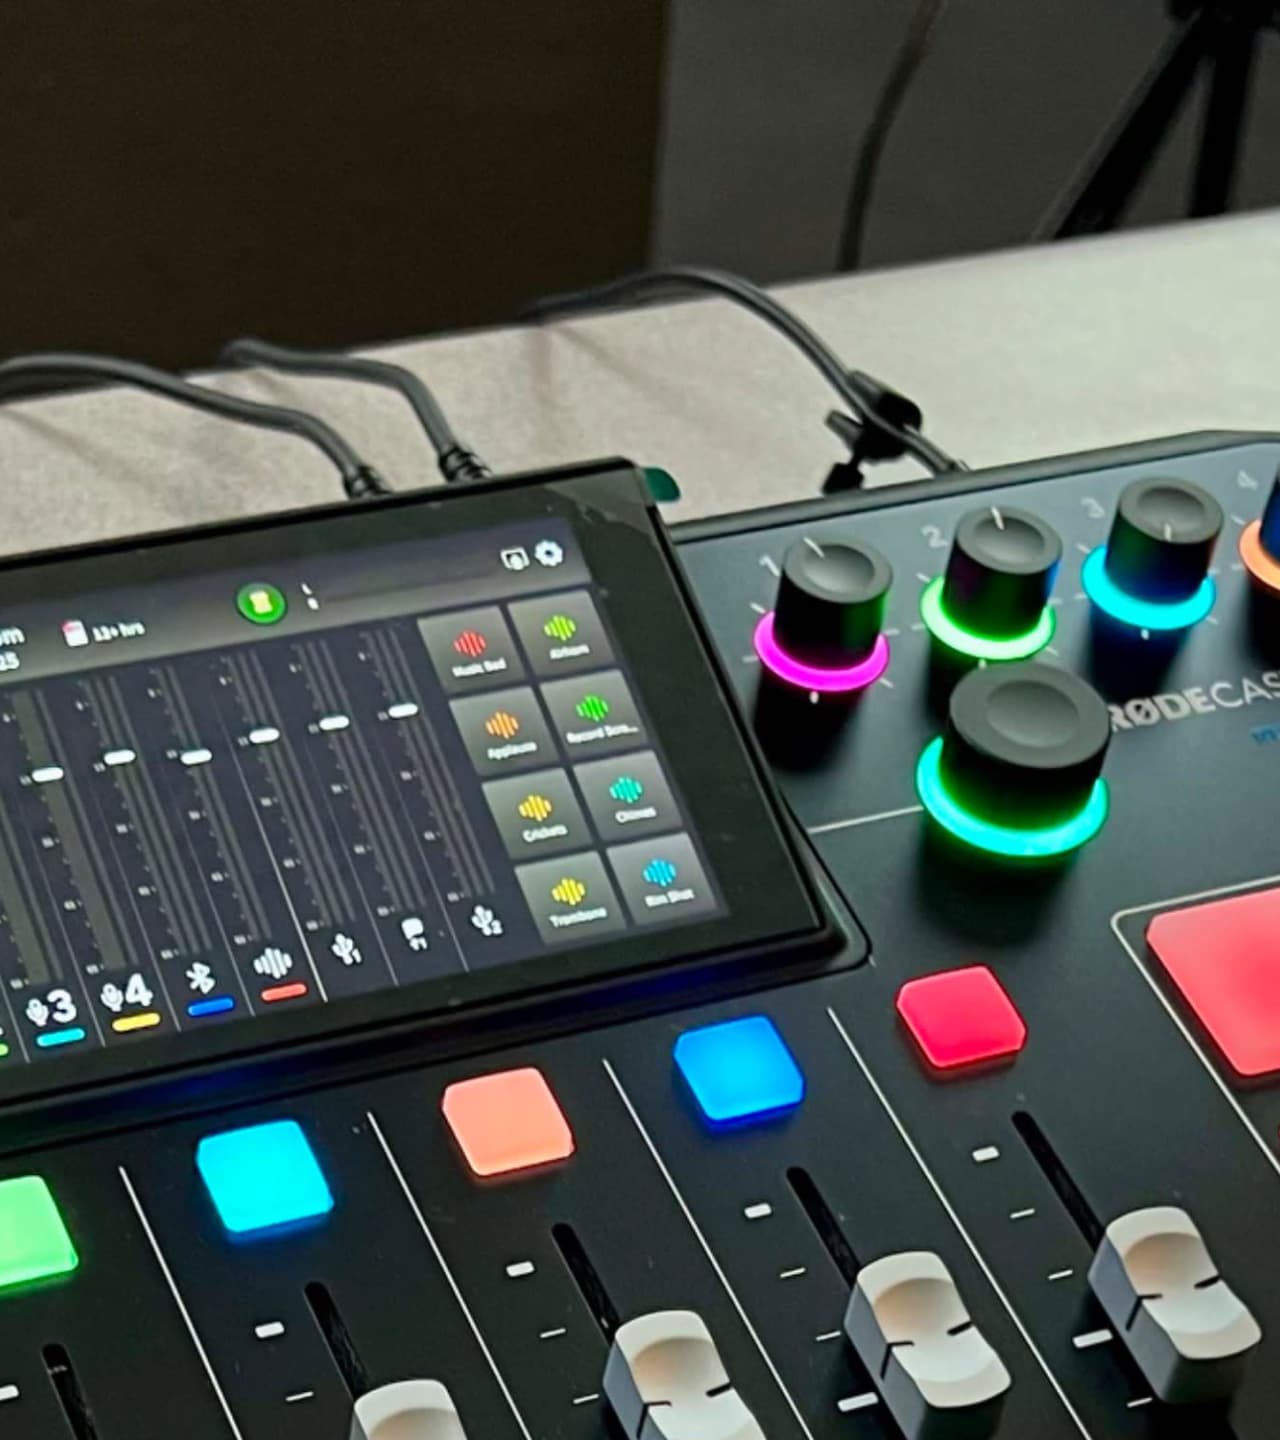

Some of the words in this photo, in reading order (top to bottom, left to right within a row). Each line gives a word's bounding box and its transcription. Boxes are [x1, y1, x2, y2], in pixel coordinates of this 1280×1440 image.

[1081, 496, 1106, 520] 3
[921, 525, 949, 549] 2
[759, 554, 782, 578] 1
[124, 972, 154, 1007] 4
[47, 988, 78, 1024] 3
